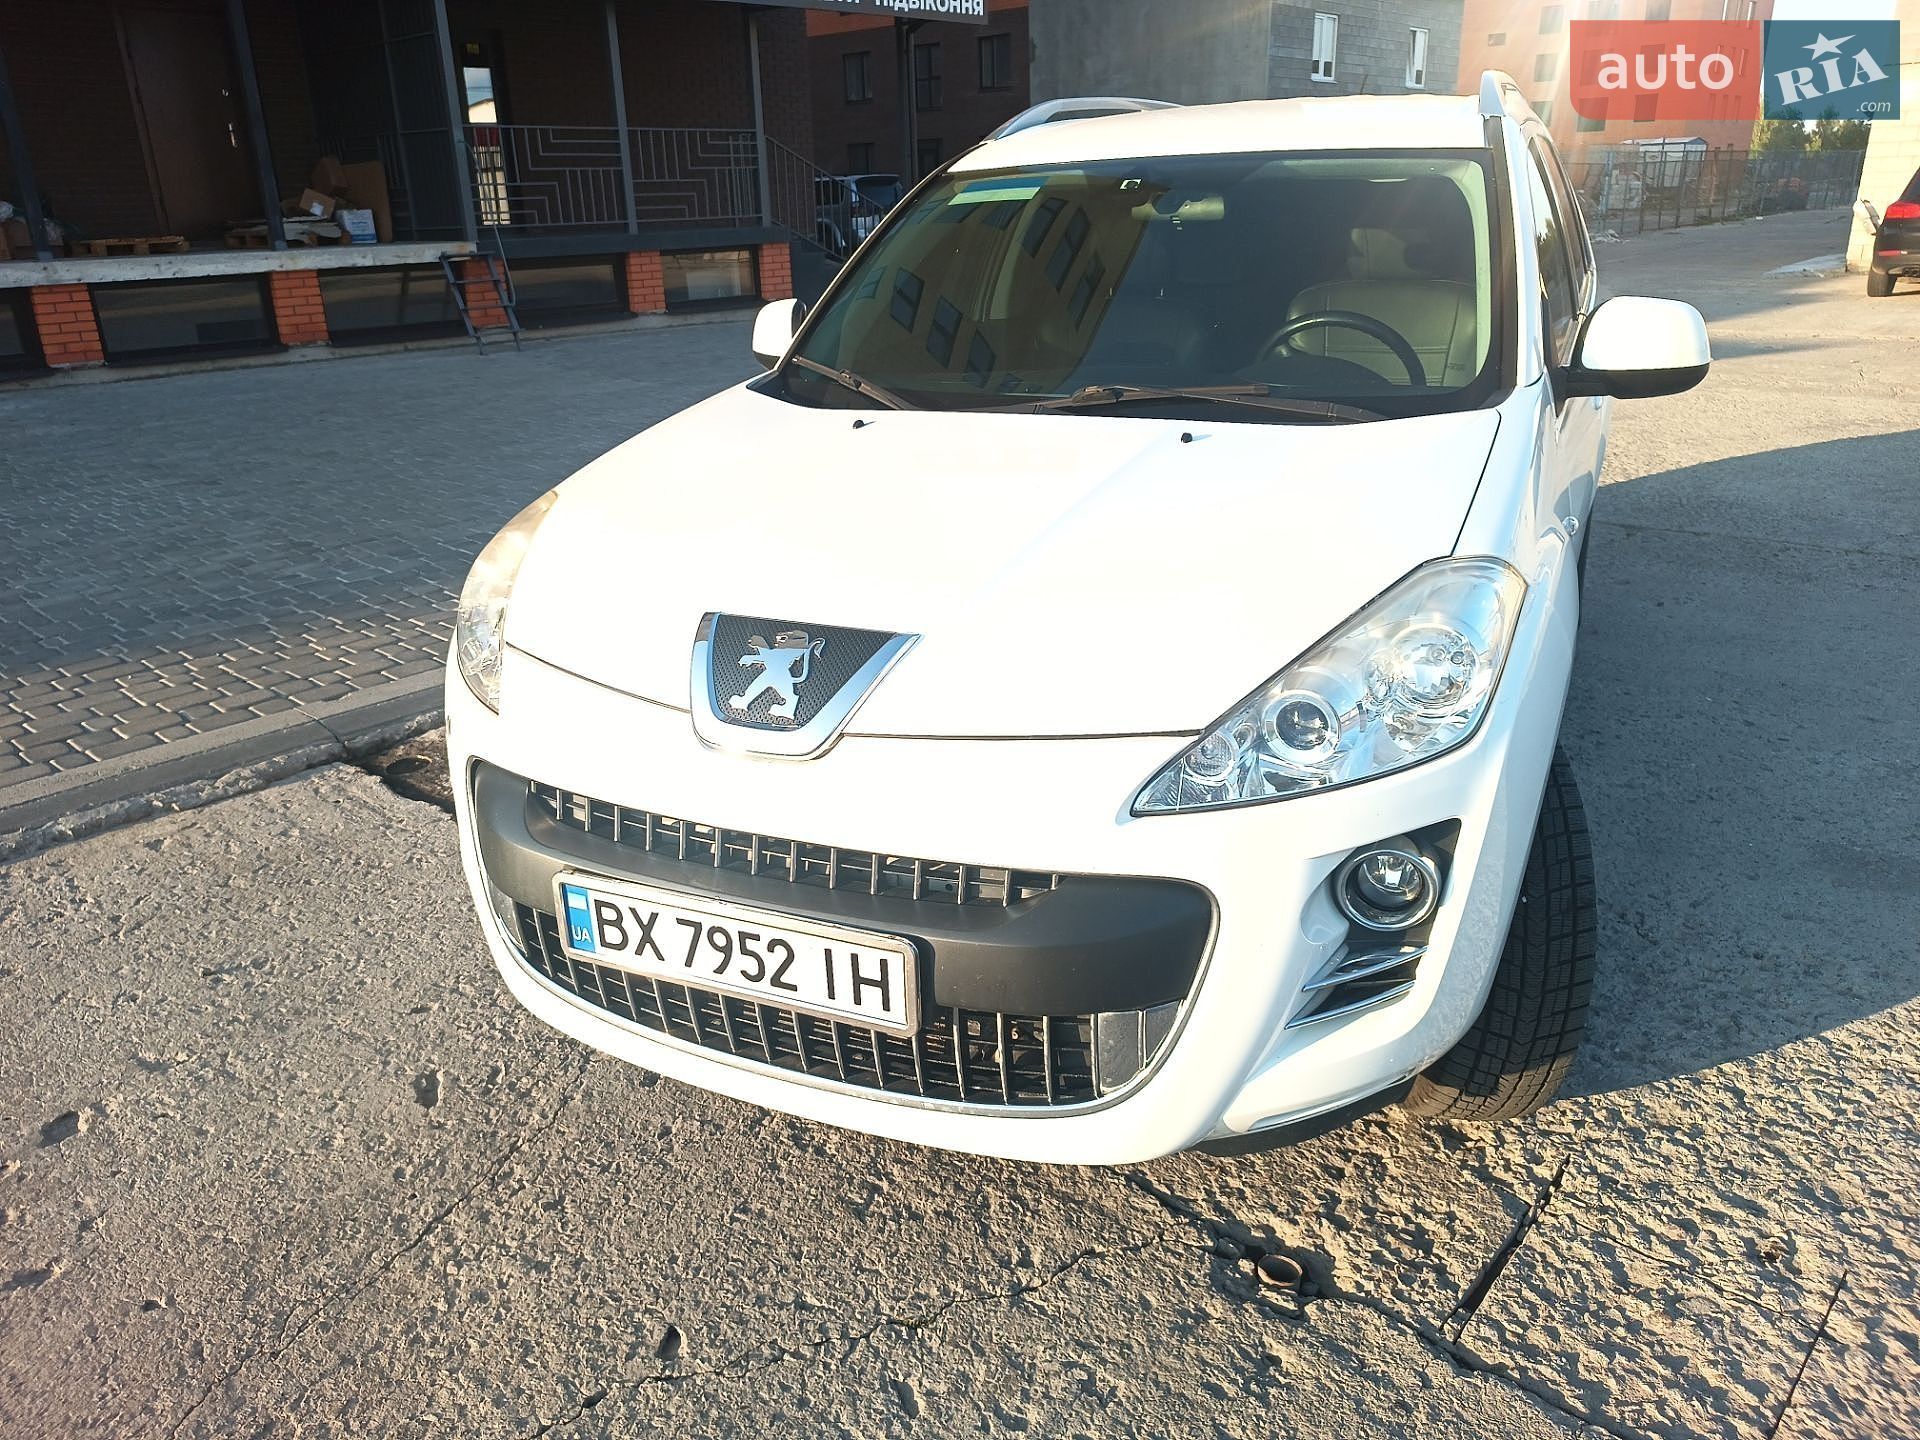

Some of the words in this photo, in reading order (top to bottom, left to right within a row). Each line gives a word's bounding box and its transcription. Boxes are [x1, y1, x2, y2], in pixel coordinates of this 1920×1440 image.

[571, 924, 592, 944] UA
[593, 899, 665, 962] BX
[676, 917, 798, 992] 7952
[824, 948, 891, 1012] IH
